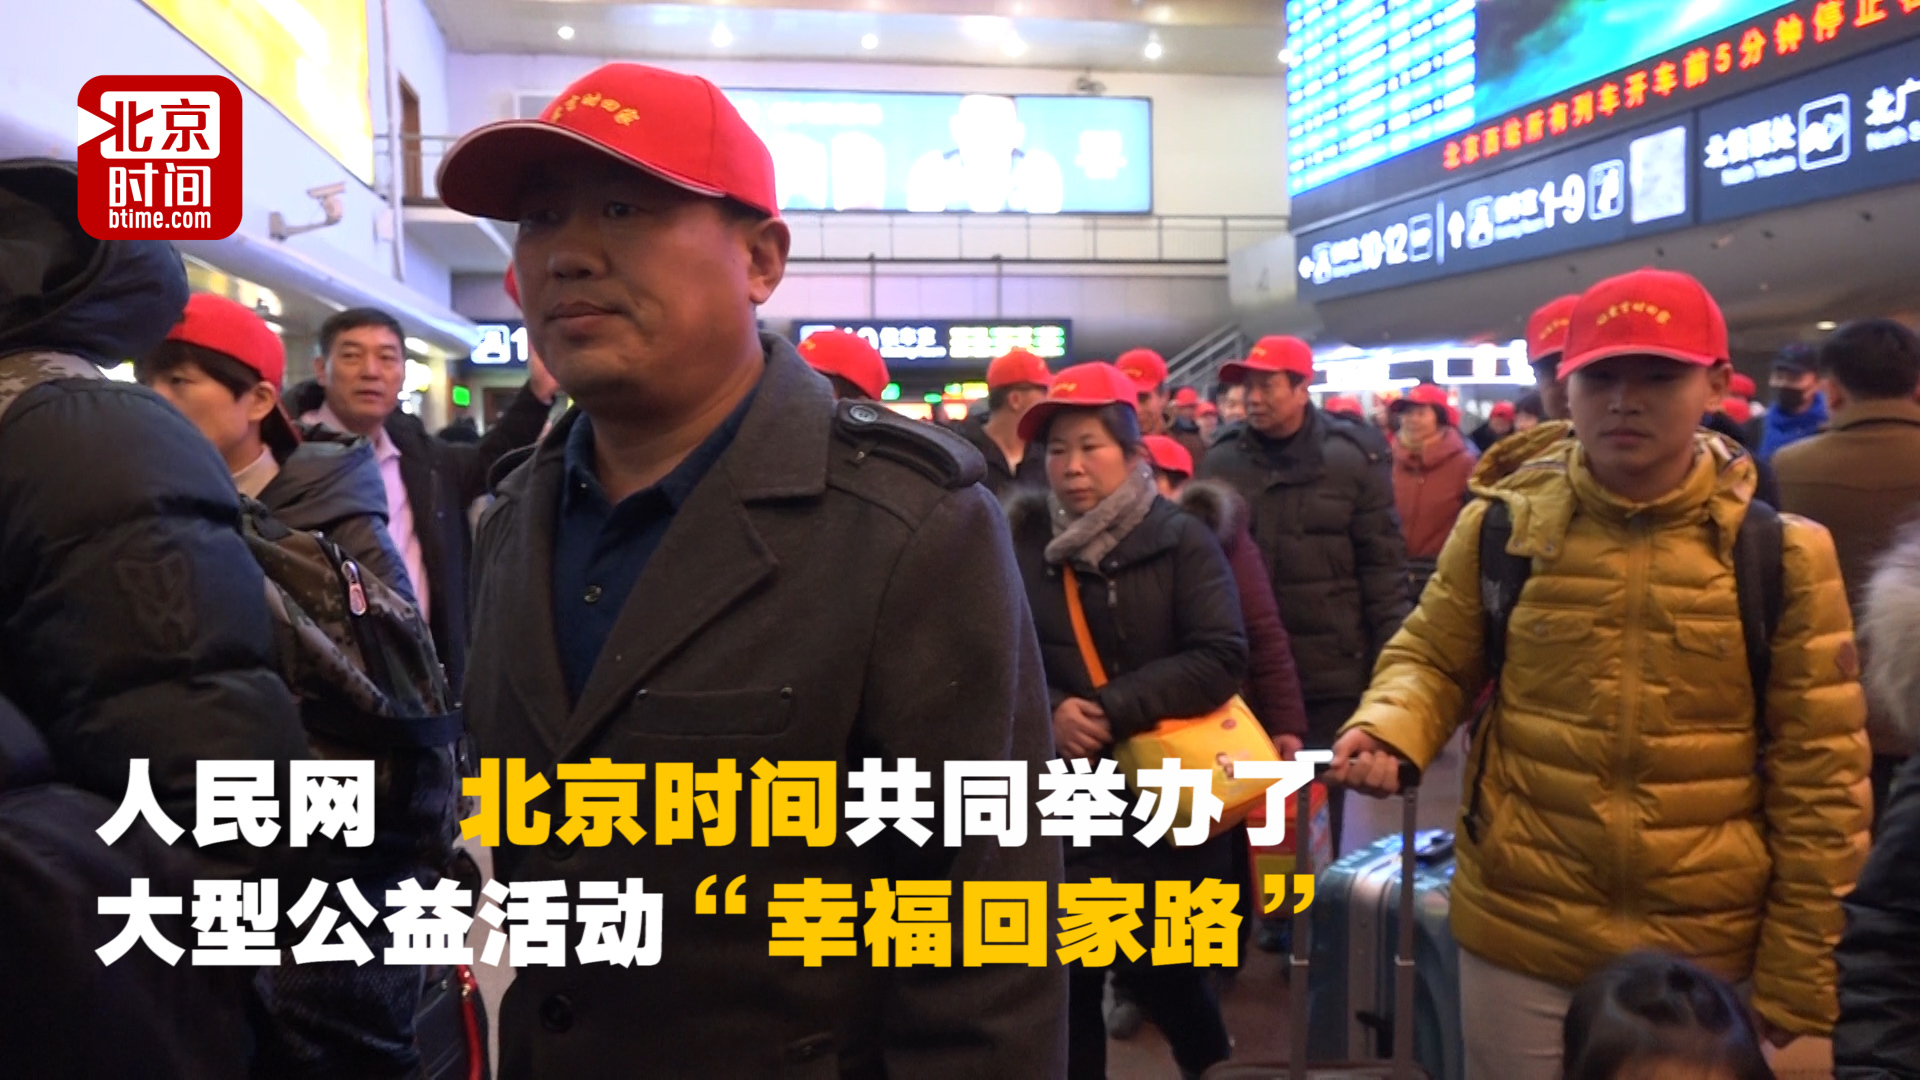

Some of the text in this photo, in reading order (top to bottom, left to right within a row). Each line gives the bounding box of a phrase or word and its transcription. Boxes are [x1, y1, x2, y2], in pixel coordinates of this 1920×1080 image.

[1443, 0, 1920, 171] 北京西站所有列车开车前5分钟停止
